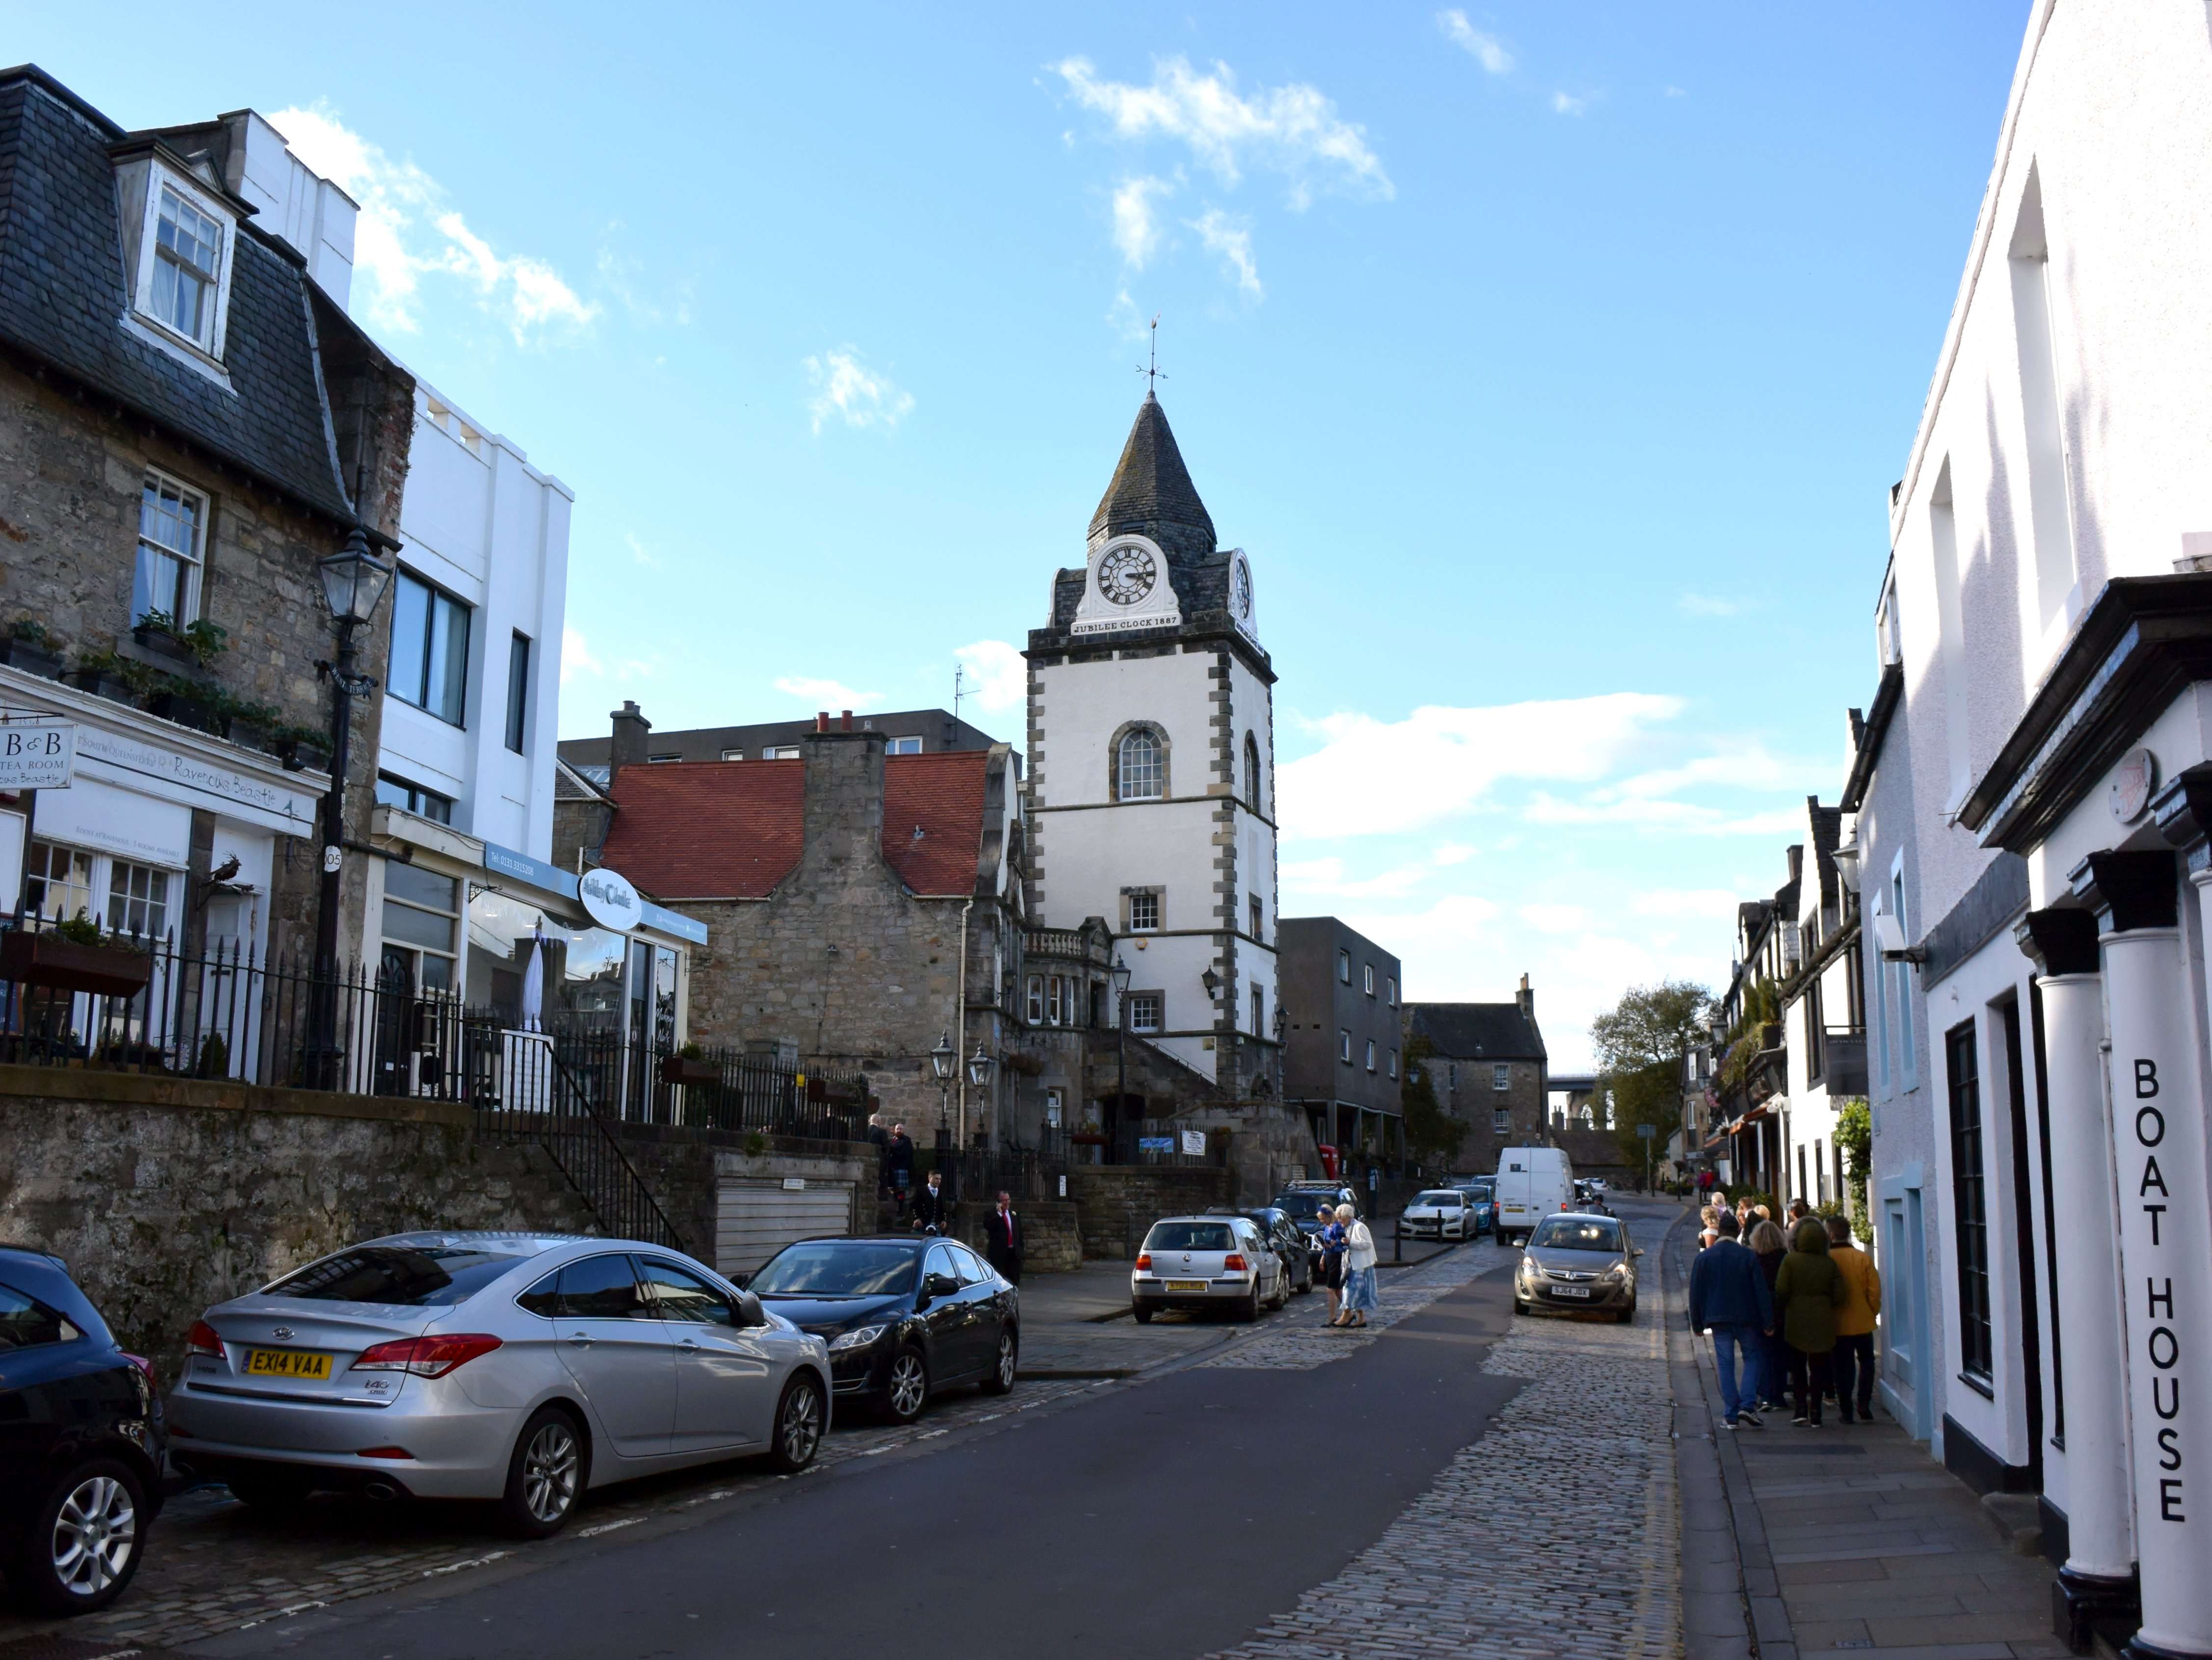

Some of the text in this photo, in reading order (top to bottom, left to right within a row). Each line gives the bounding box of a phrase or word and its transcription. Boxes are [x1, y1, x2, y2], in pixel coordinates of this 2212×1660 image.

[1074, 617, 1177, 633] JUBILEE CLOCK 1887
[5, 733, 61, 755] B & B
[28, 761, 63, 769] ROOM
[21, 772, 59, 783] Beastie
[234, 776, 276, 806] Beastie
[325, 854, 340, 865] 05
[491, 852, 500, 863] Tel:
[501, 856, 512, 868] 0131
[2134, 1059, 2186, 1523] BOAT HOUSE
[254, 1352, 323, 1375] EX14 VAA
[365, 1379, 389, 1389] i40
